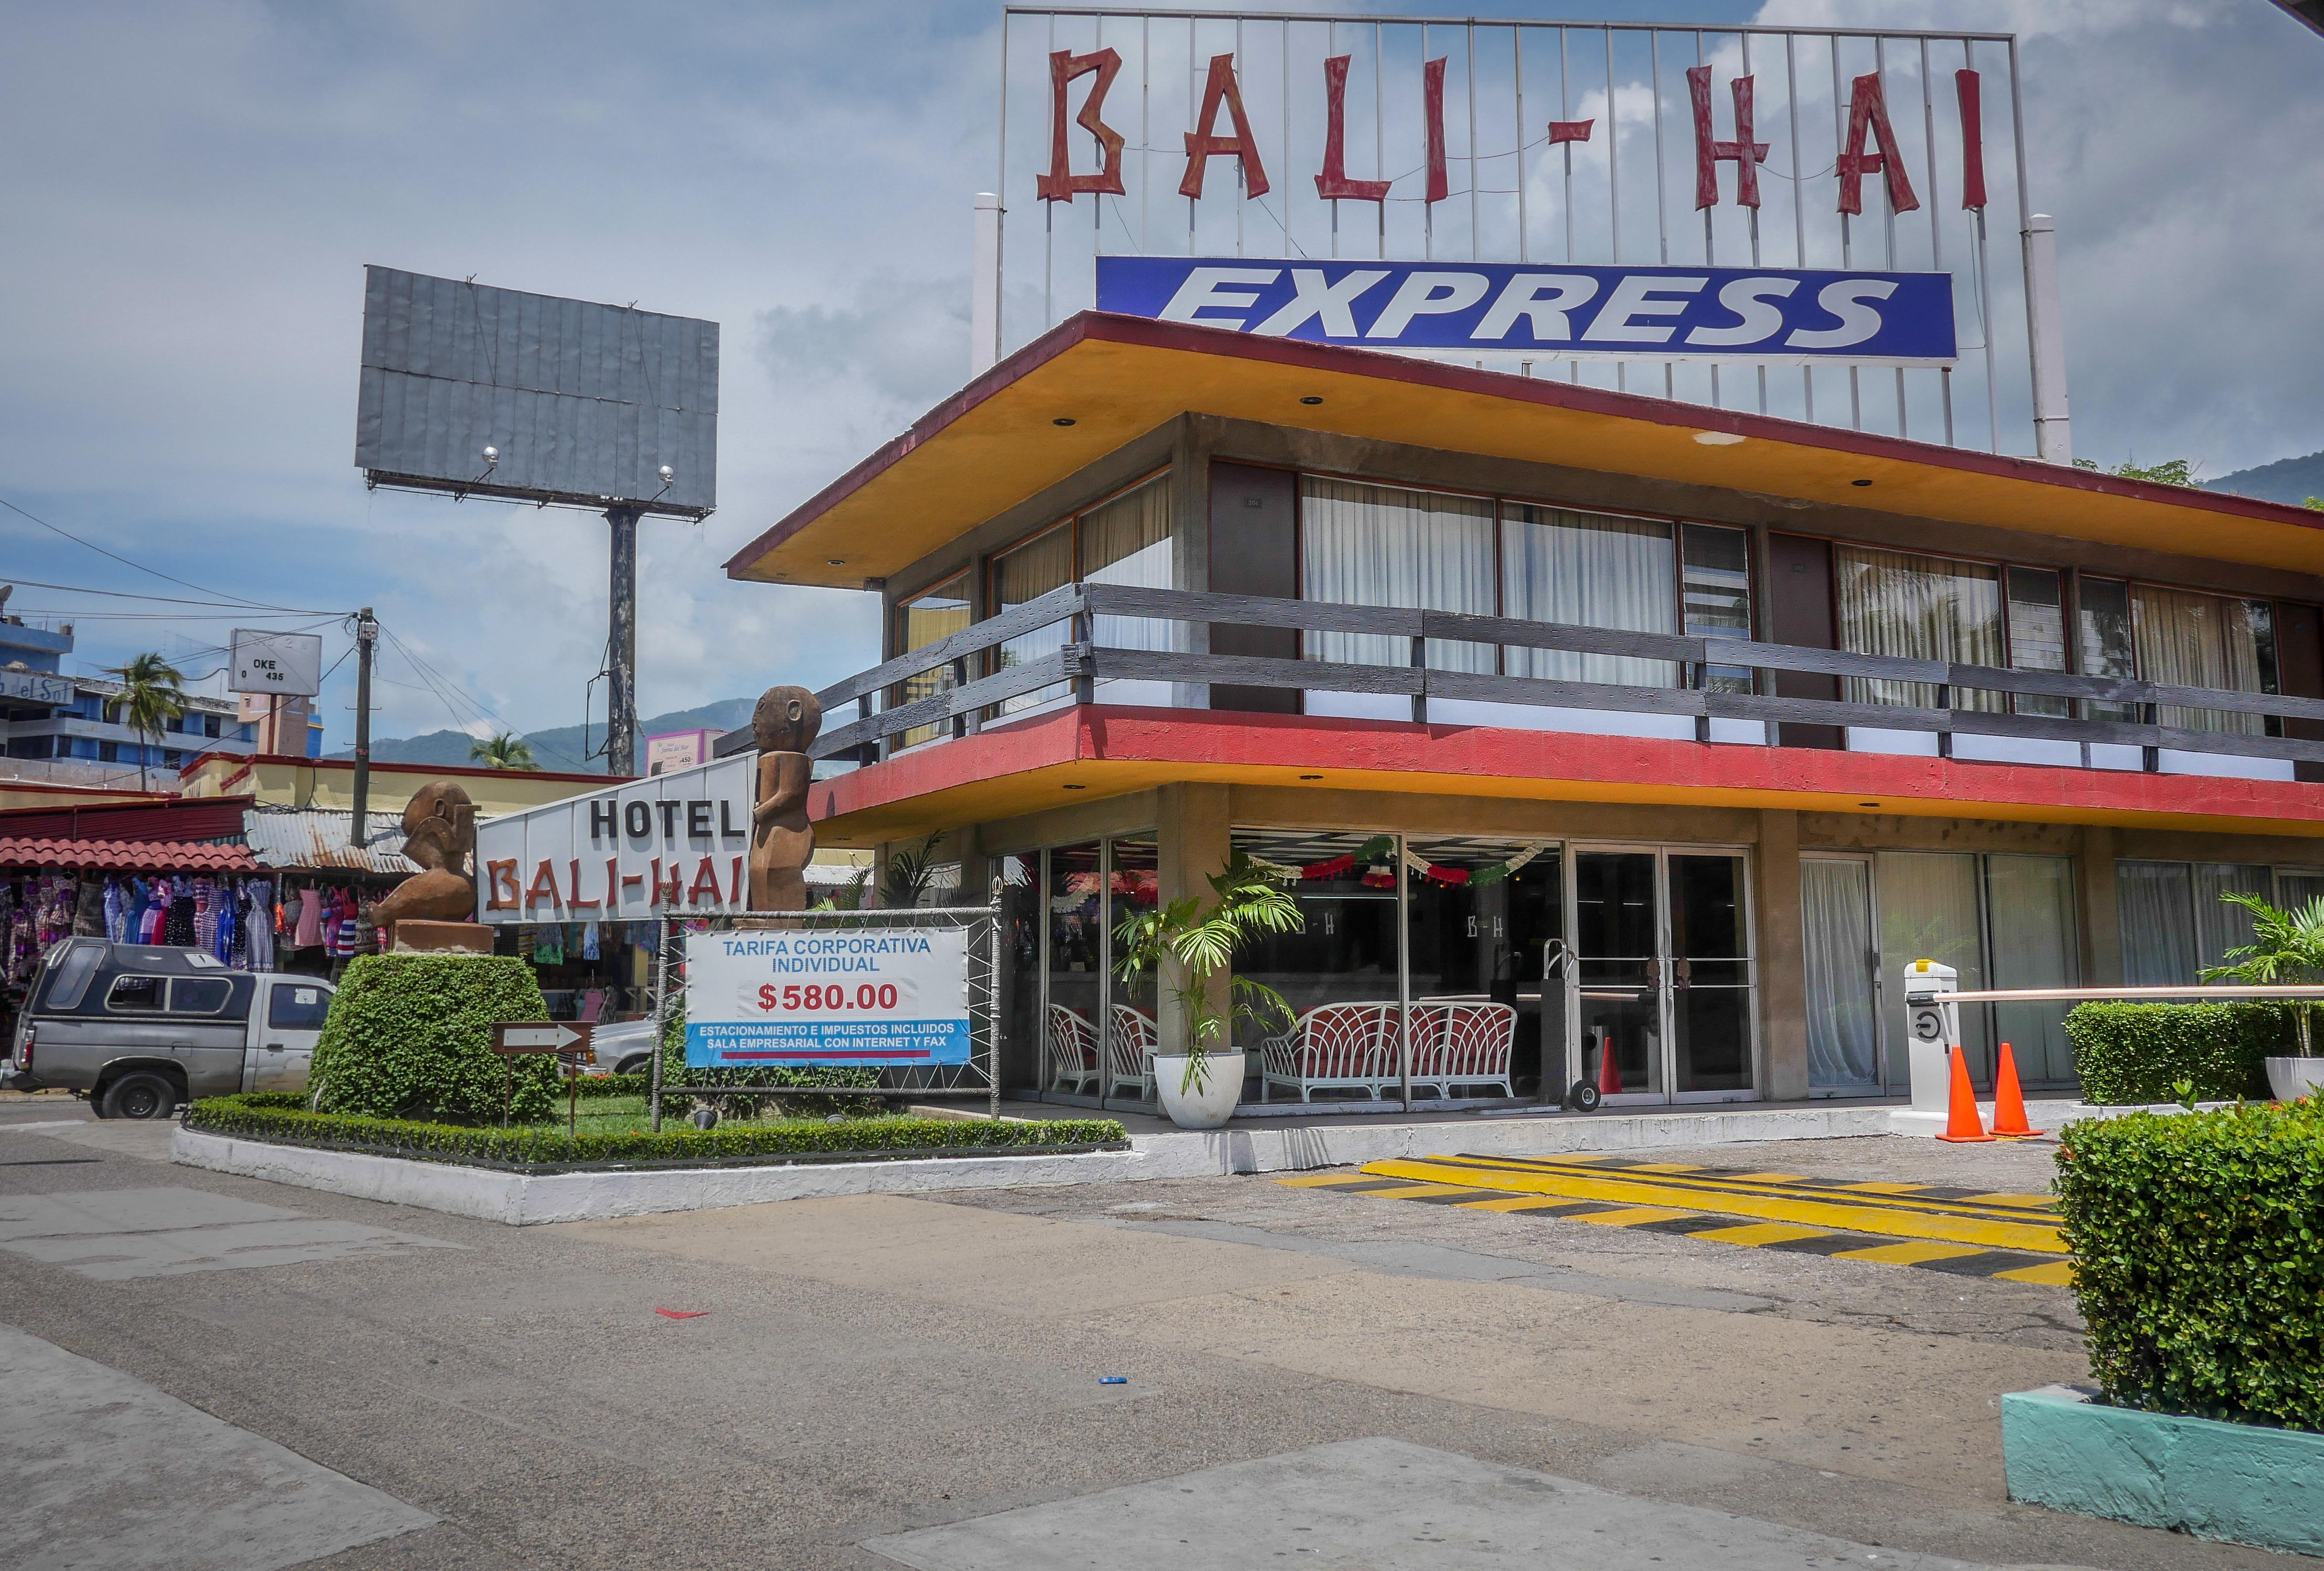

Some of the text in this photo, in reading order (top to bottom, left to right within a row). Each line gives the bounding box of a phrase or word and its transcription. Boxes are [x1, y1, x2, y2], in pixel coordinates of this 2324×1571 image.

[1156, 267, 1899, 348] EXPRESS
[254, 659, 276, 670] OKE
[266, 672, 284, 681] 435
[11, 676, 35, 699] del
[40, 679, 68, 703] Sol
[590, 799, 746, 838] HOTEL
[486, 855, 743, 911] BALI-HAI
[723, 937, 931, 956] TARIFA CORPORATIVA
[772, 956, 880, 973] INDIVIDUAL
[758, 983, 898, 1013] $580.00
[700, 1024, 954, 1036] ESTACIONAMIENTO E IMPUESTOS INCLUIDOS
[707, 1036, 947, 1048] SALA EMPRESARIAL CON INTERNET Y FAX
